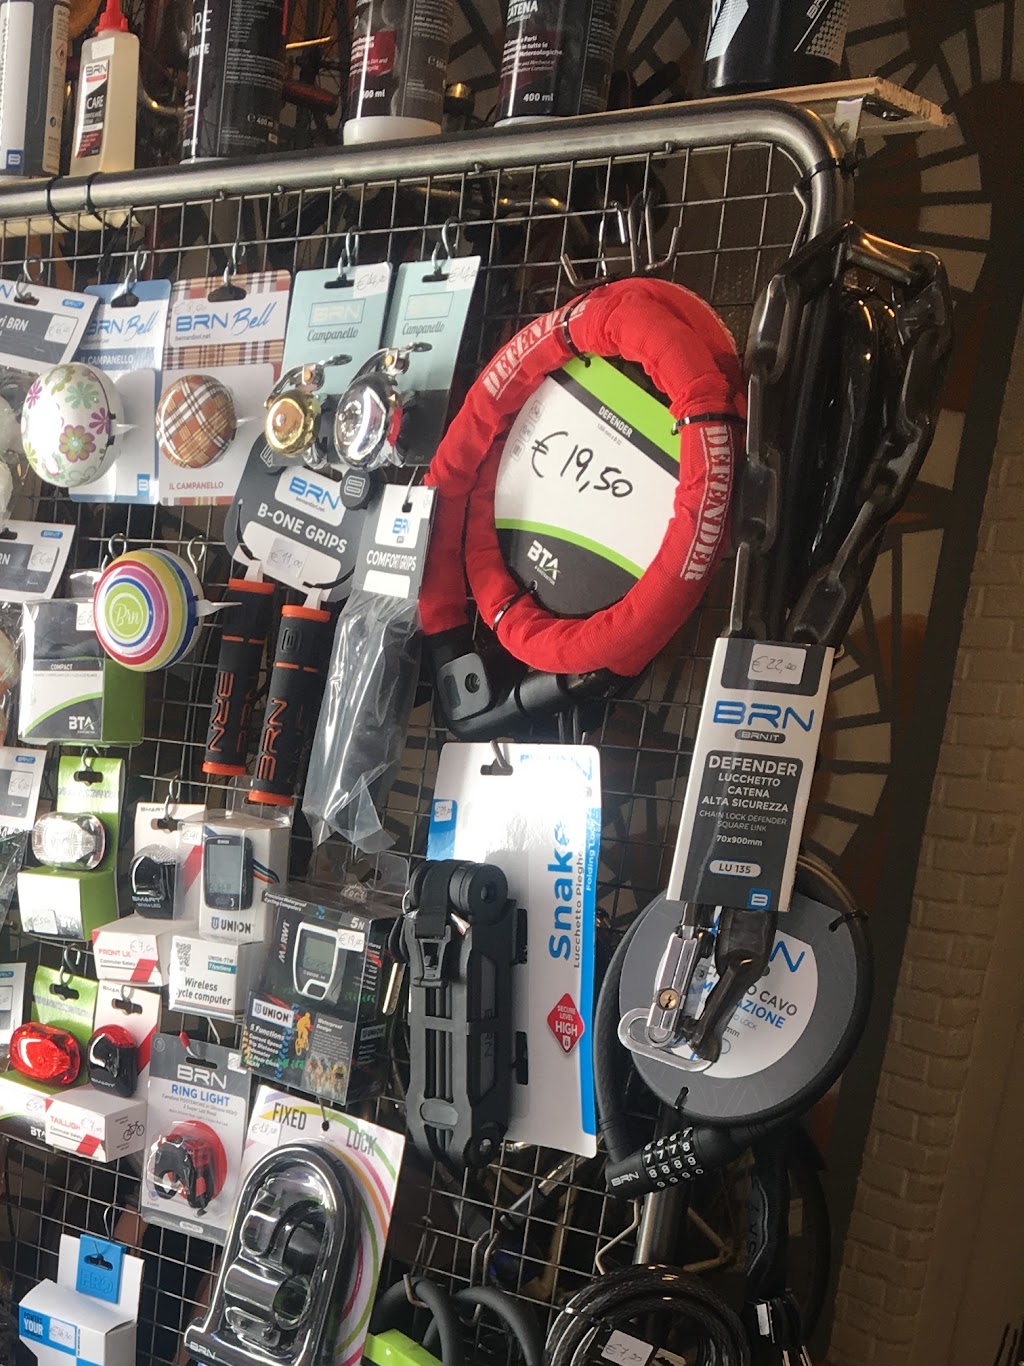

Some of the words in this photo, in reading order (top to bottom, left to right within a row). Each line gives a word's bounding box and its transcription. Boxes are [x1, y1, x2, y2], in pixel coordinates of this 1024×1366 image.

[86, 65, 107, 76] BRN
[86, 95, 104, 110] CARE
[523, 93, 541, 102] 400
[543, 93, 554, 101] ml
[8, 317, 29, 332] BRN
[87, 319, 123, 336] BRN
[124, 311, 158, 340] Bell
[175, 312, 228, 332] BRN
[231, 302, 277, 336] Bell
[307, 328, 359, 343] Campanello
[402, 322, 445, 338] Campanello
[87, 354, 134, 366] CAMPANELLO
[598, 405, 633, 438] DEFENDER
[177, 480, 224, 490] CAMPANELLO
[289, 476, 340, 511] BRN
[680, 425, 734, 581] DEFENDER
[257, 502, 305, 535] B-ONE
[305, 525, 348, 554] GRIPS
[392, 518, 411, 536] BRN
[366, 549, 399, 569] COMFORT
[398, 555, 417, 572] GRIPS
[527, 539, 561, 578] BTA
[116, 604, 140, 627] Brn
[50, 663, 74, 671] COMPACT
[68, 716, 95, 731] BTA
[713, 700, 815, 732] BRN
[708, 755, 798, 777] DEFENDER
[718, 773, 781, 787] LUCCHETTO
[727, 786, 770, 799] CATENA
[701, 795, 730, 807] ALTA
[732, 798, 789, 814] SICUREZZA
[699, 809, 724, 820] CHAIN
[726, 812, 746, 822] LOCK
[747, 814, 787, 826] DEFENDER
[717, 820, 749, 831] SQUARE
[751, 824, 767, 832] LINK
[716, 834, 763, 847] 70x900mm
[585, 848, 596, 891] Folding
[718, 862, 733, 873] LU
[735, 864, 751, 874] 135
[221, 919, 251, 934] UNION
[574, 901, 582, 969] Lucchetto
[184, 977, 218, 992] Wireless
[176, 987, 193, 998] ycle
[194, 991, 231, 1006] computer
[759, 990, 798, 1017] CAVO
[262, 1006, 289, 1023] UNION
[557, 1003, 576, 1013] SECURE
[559, 1012, 574, 1022] LEVEL
[256, 1025, 285, 1041] Functions
[555, 1022, 578, 1037] HIGH
[177, 1064, 227, 1090] BRN
[171, 1084, 198, 1099] RING
[200, 1091, 230, 1107] LIGHT
[272, 1102, 307, 1132] FIXED
[346, 1128, 376, 1156] LOCK
[611, 1171, 639, 1187] BRN
[24, 1318, 44, 1336] YOUR
[190, 1341, 216, 1360] BRN
